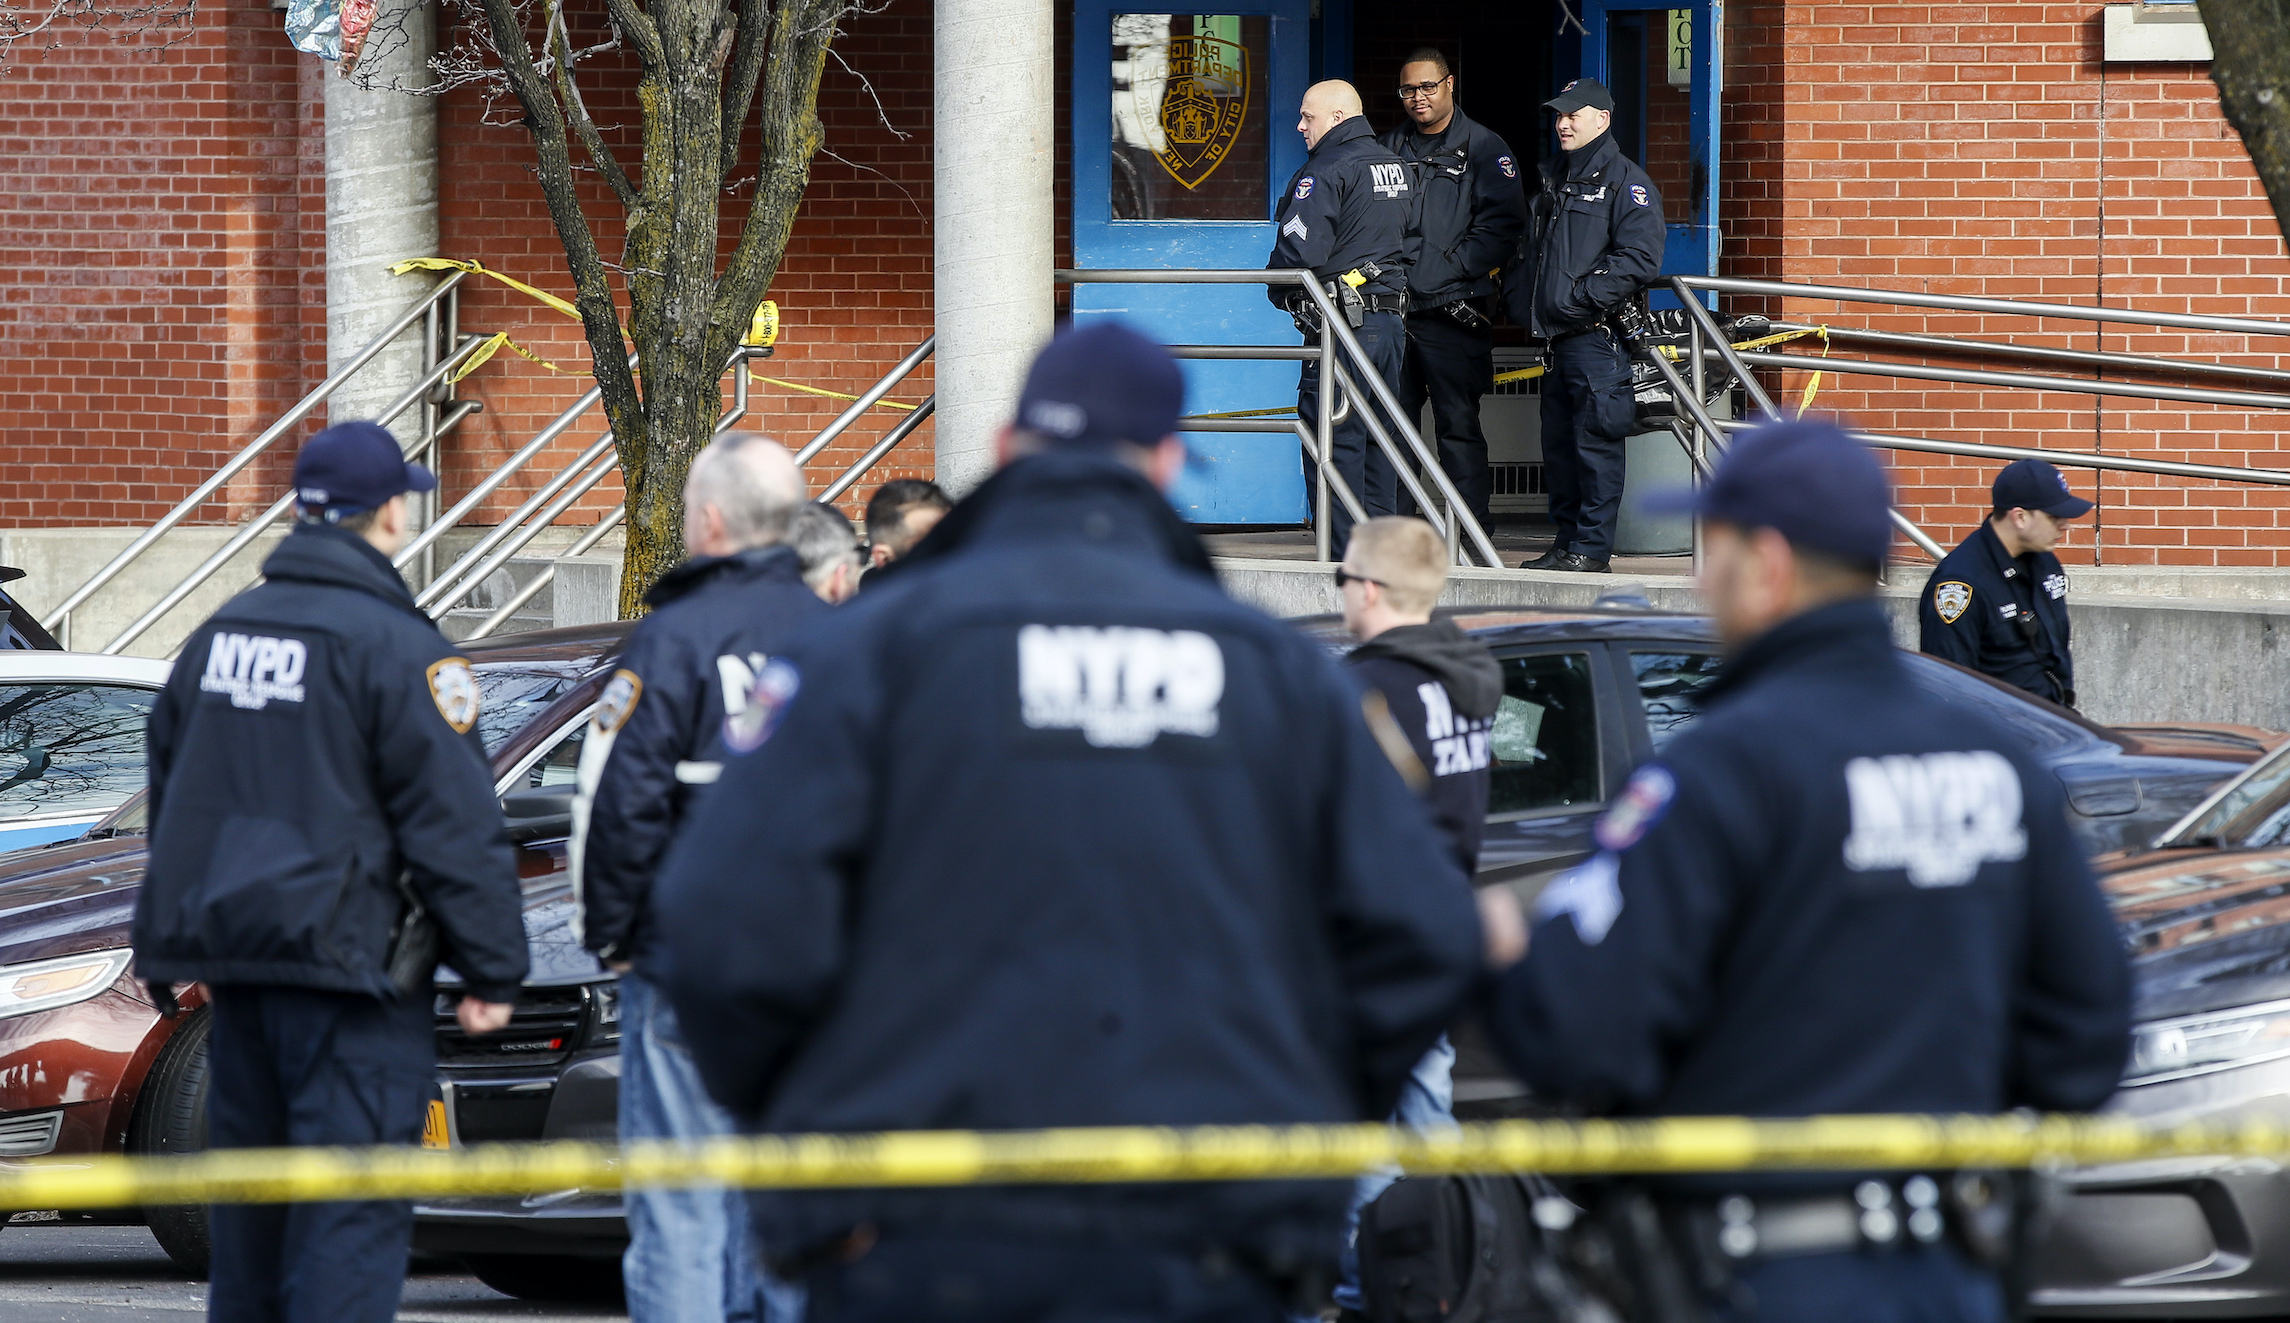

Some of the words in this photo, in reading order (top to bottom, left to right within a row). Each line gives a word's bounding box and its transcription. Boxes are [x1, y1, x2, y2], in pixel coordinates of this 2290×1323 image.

[1370, 163, 1404, 186] NYPD
[205, 631, 307, 687] NYPD
[1017, 623, 1225, 709] NYPD
[1845, 750, 2024, 836] NYPD
